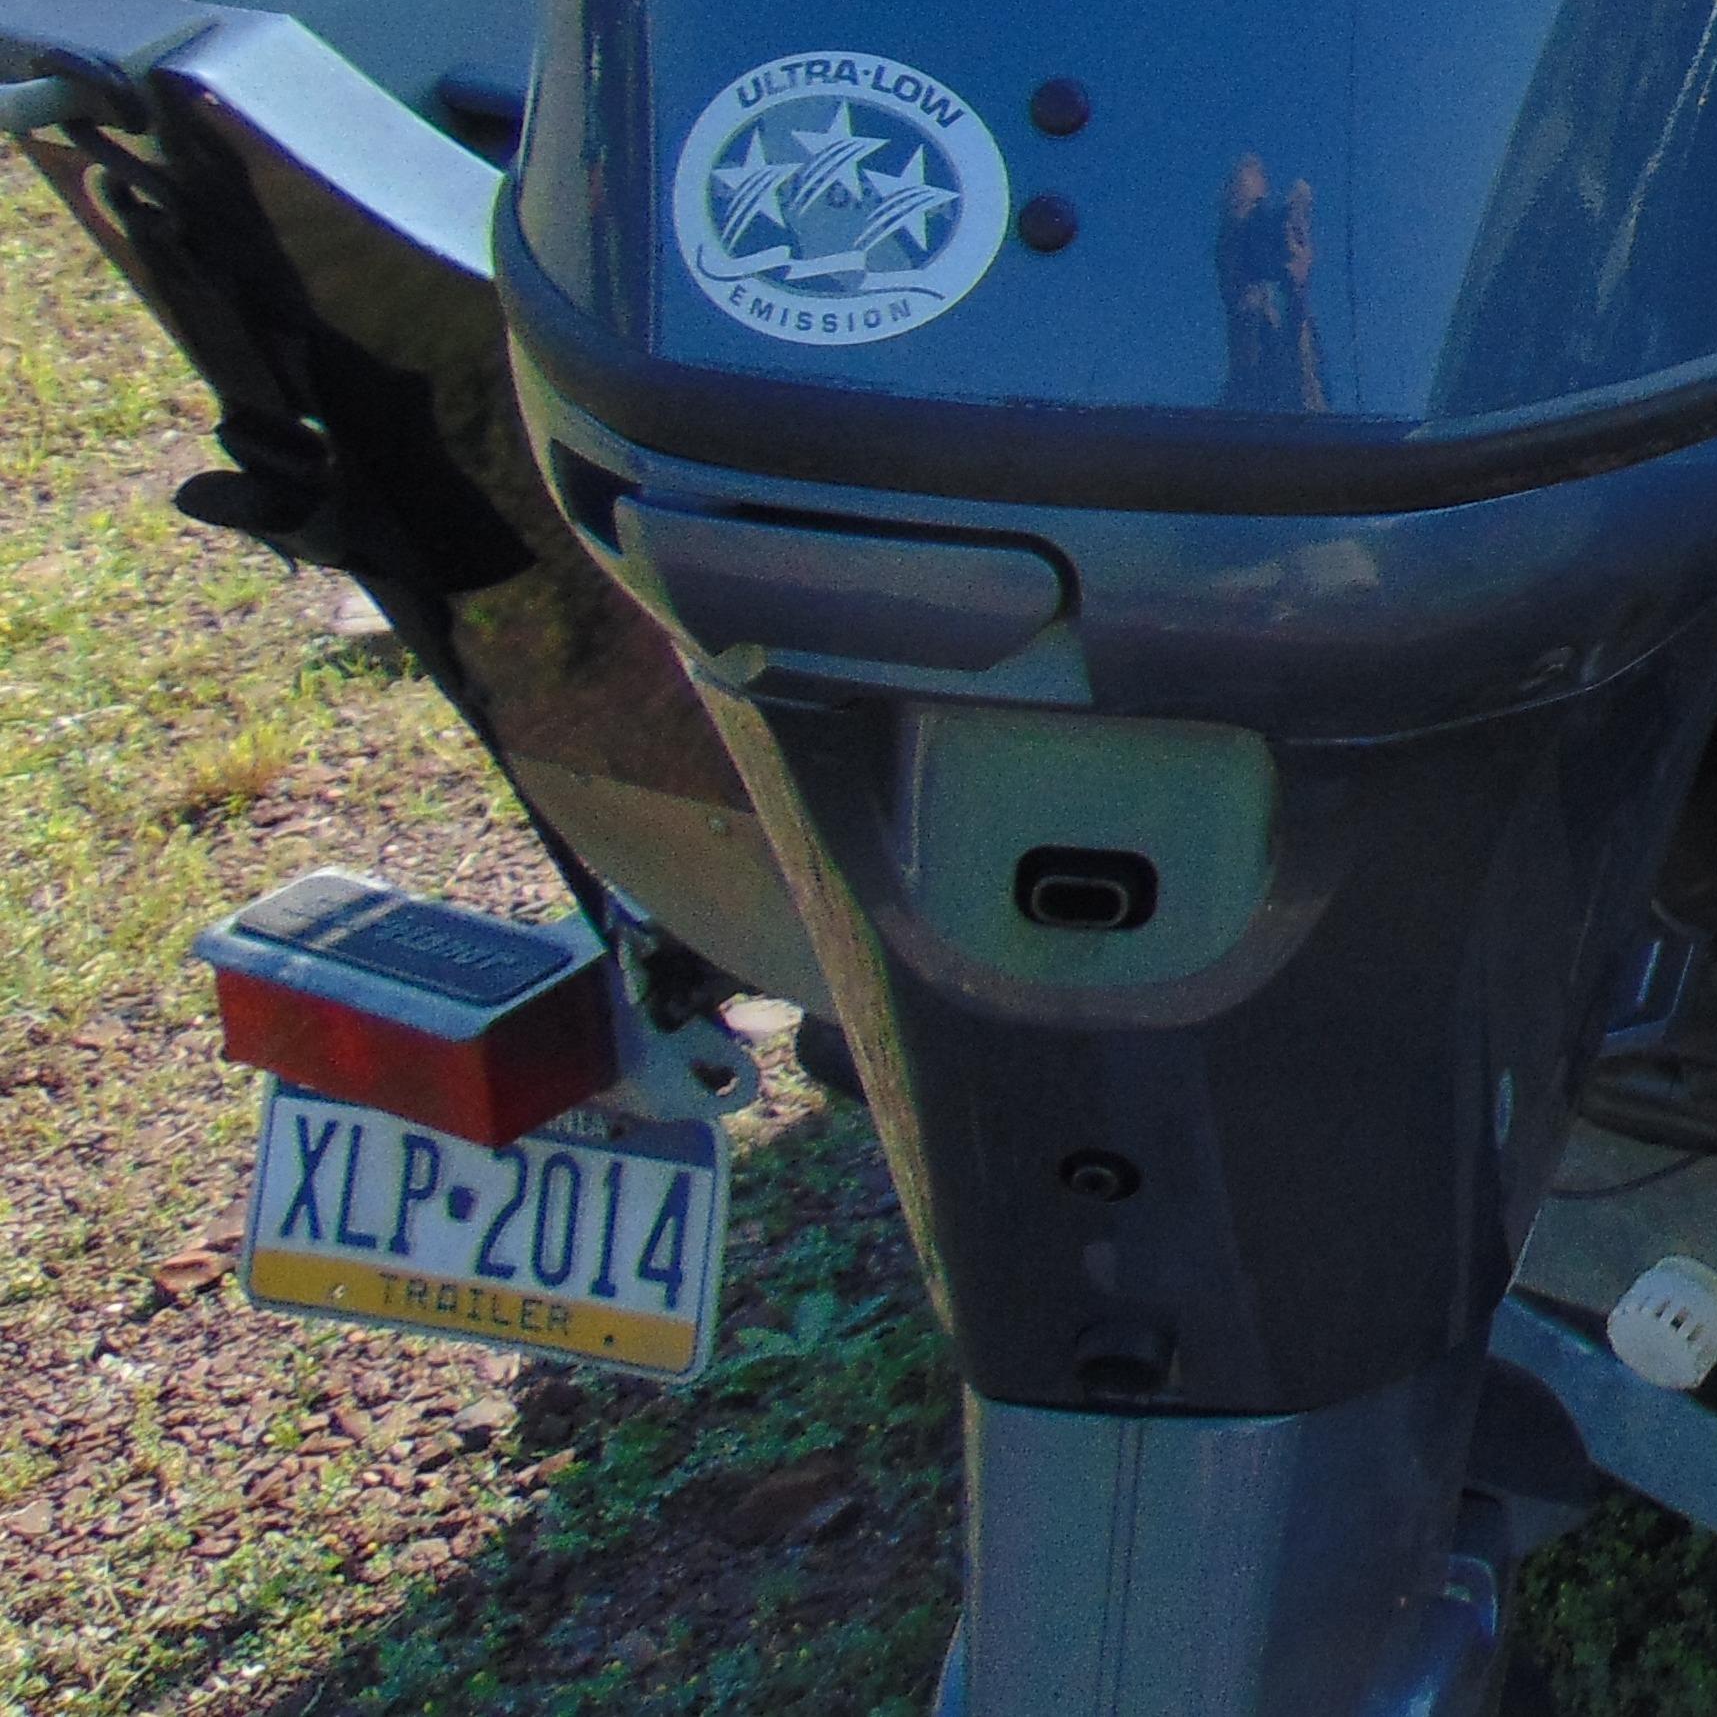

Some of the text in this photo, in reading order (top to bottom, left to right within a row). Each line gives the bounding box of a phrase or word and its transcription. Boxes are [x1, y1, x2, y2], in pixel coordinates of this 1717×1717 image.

[727, 284, 912, 334] EMISSION
[280, 1114, 692, 1310] XLP 2014
[378, 1271, 571, 1337] TRAILER
